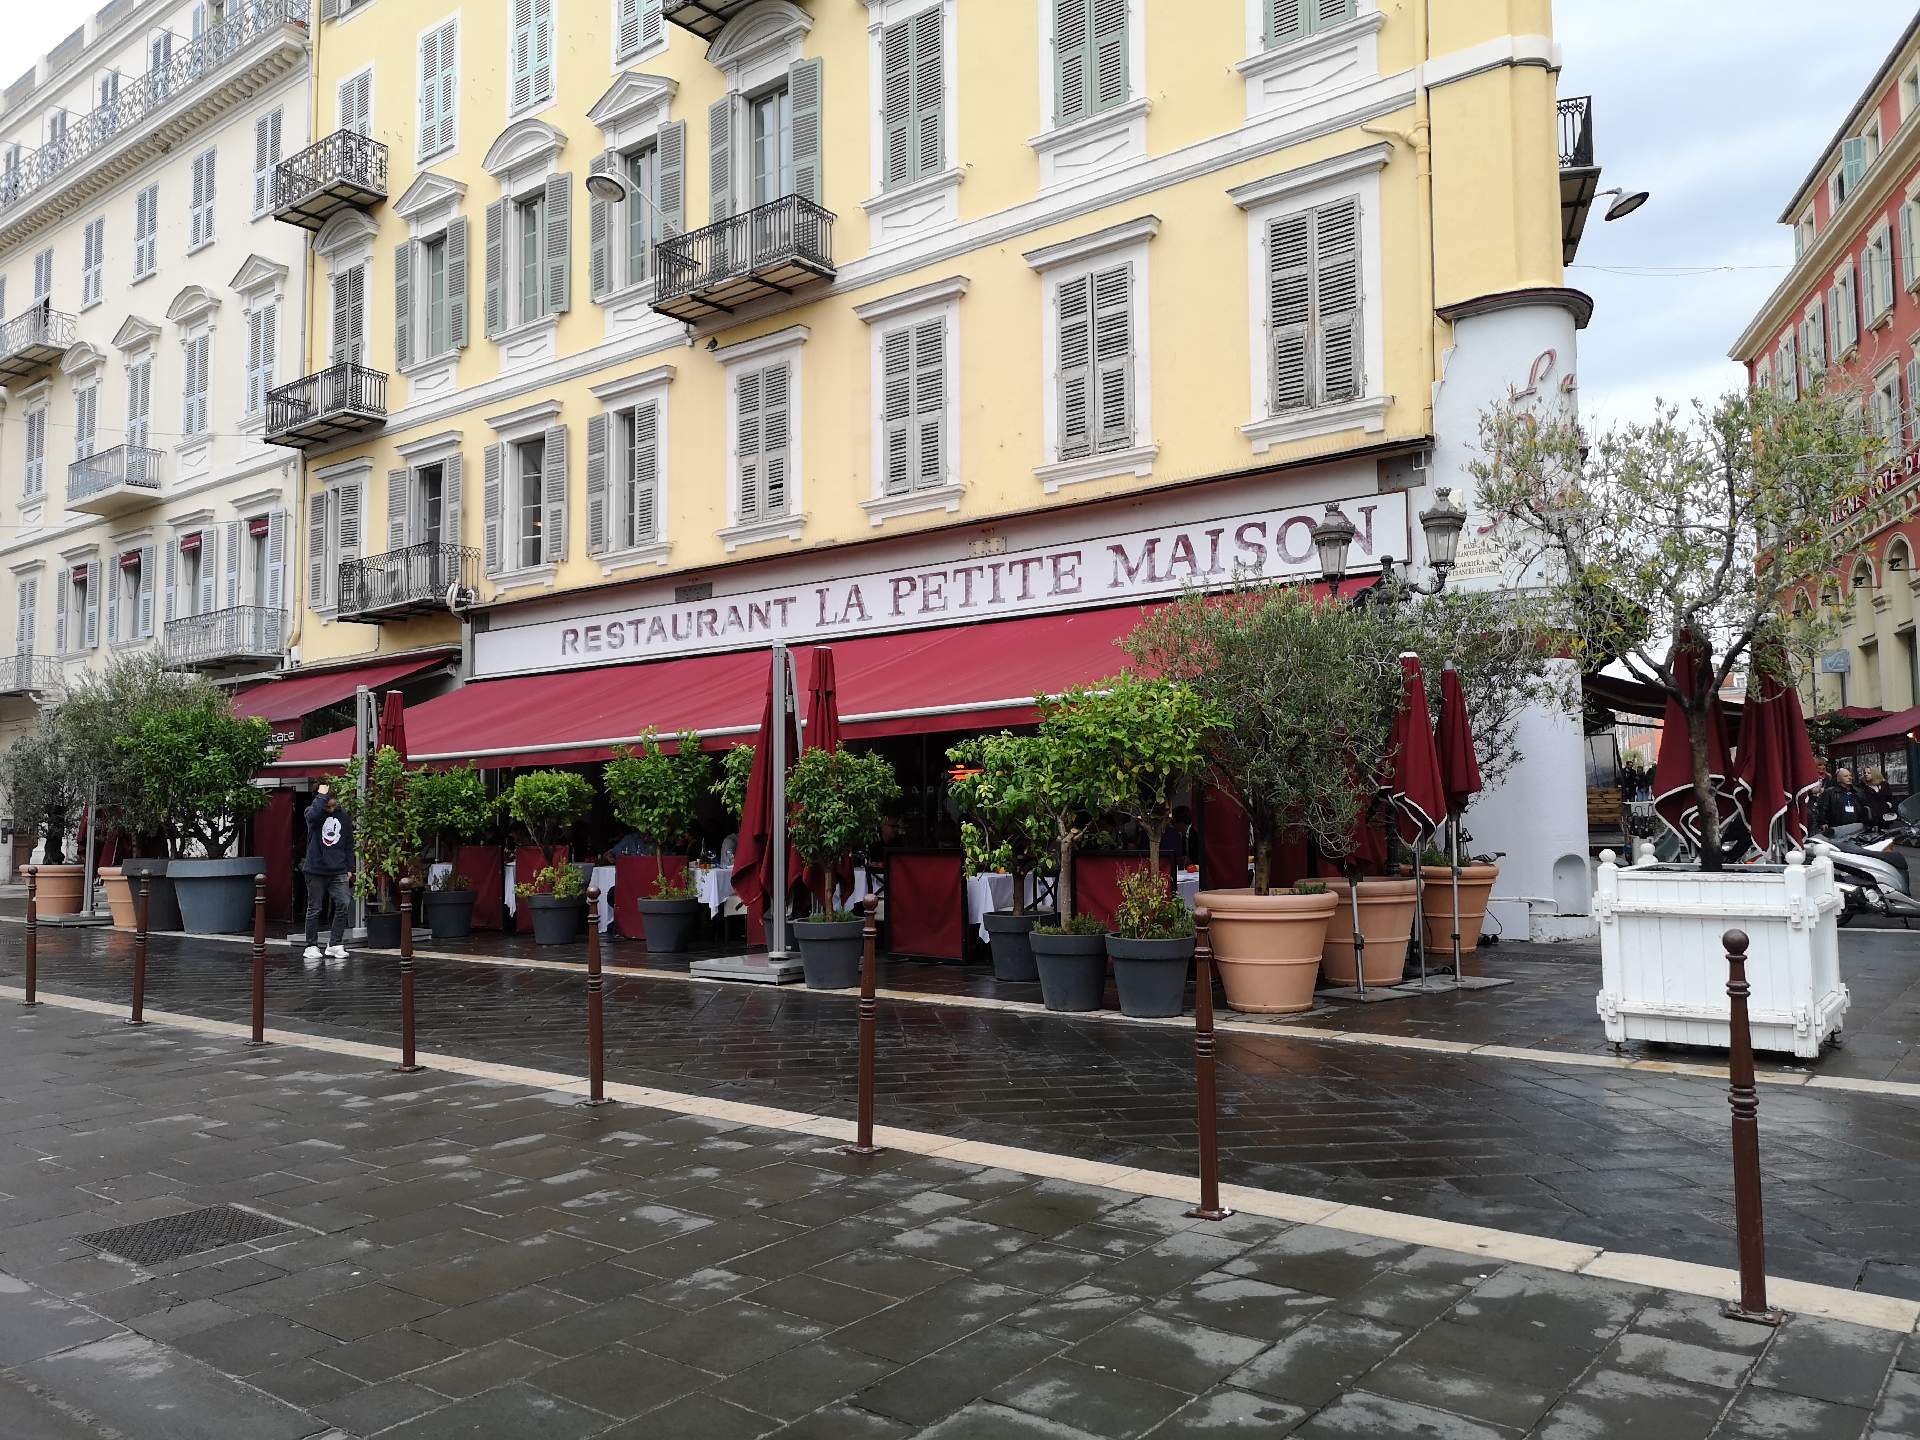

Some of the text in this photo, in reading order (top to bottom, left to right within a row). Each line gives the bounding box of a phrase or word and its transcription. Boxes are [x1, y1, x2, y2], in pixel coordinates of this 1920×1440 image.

[561, 504, 1377, 656] RESTAURANT LA PETITE MAISON
